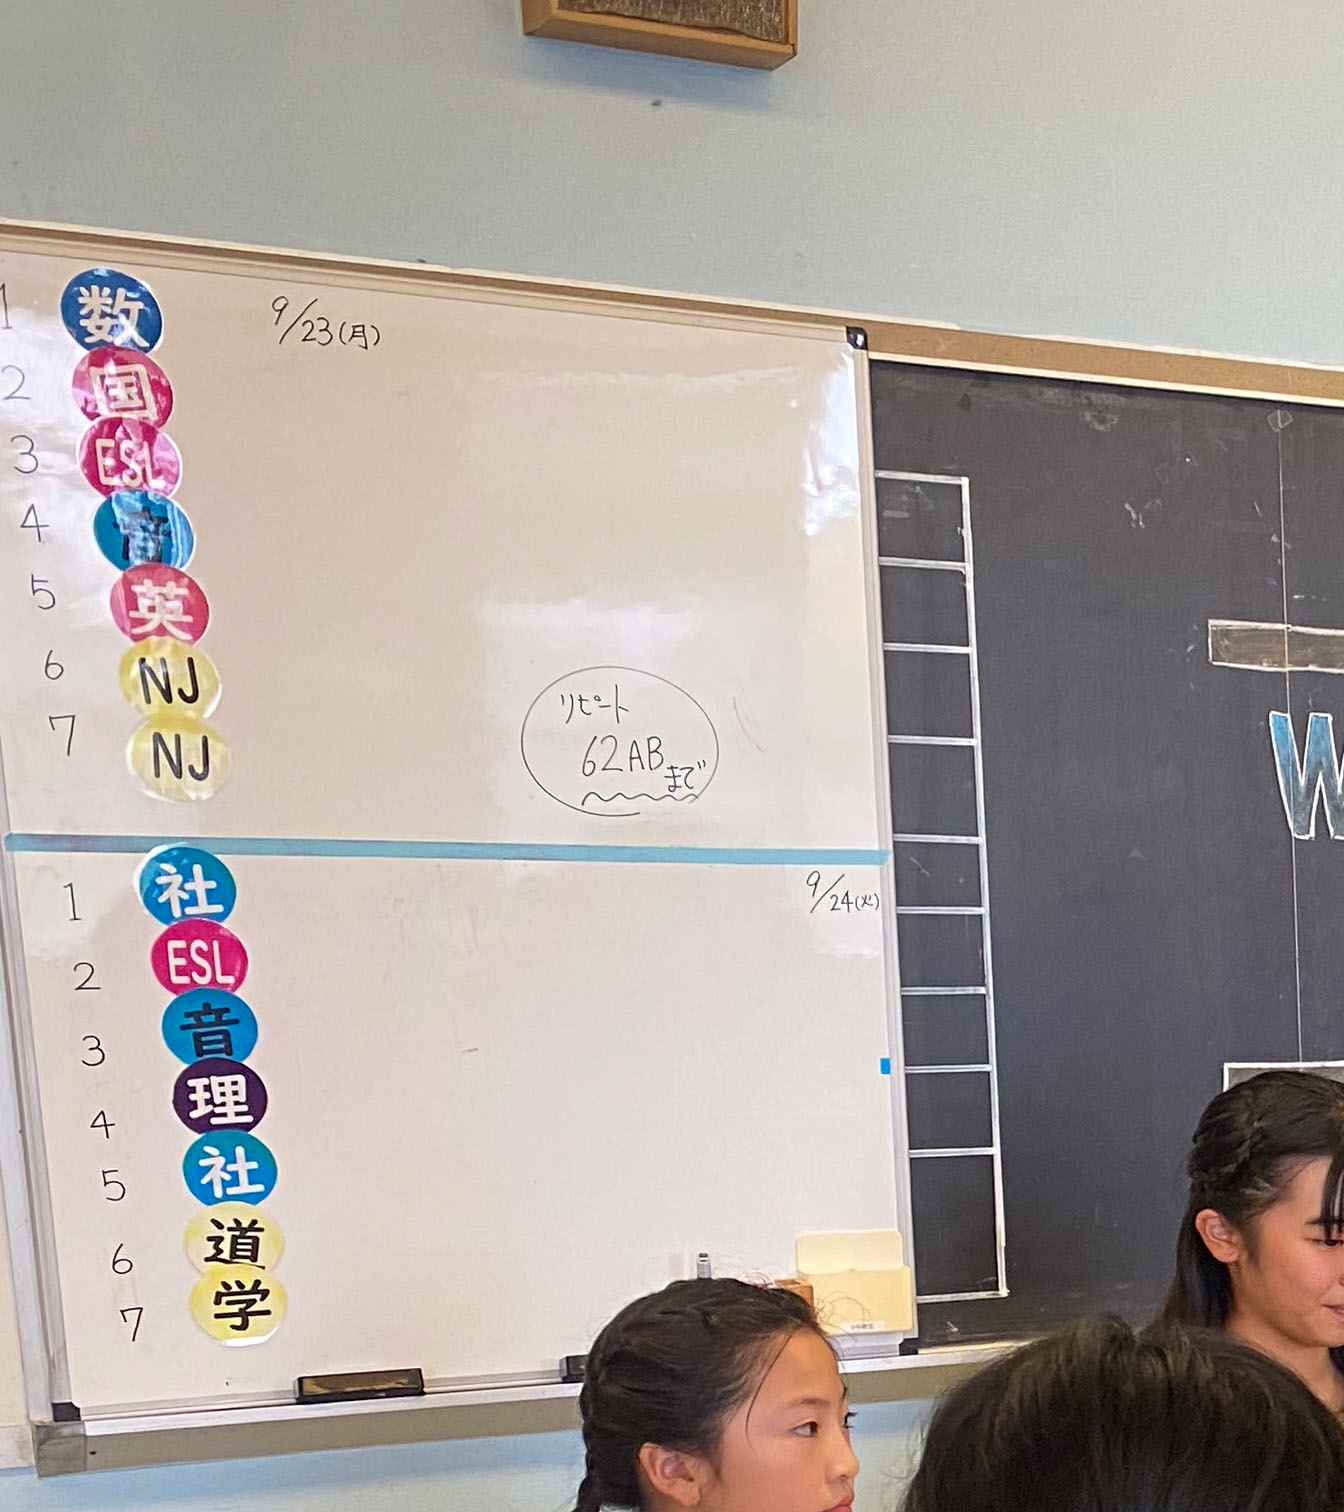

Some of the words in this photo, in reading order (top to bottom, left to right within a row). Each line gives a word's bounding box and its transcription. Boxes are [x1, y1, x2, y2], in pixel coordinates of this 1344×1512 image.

[78, 284, 150, 348] 数
[271, 295, 381, 350] 9/23(月)
[1, 364, 32, 401] 2
[89, 362, 160, 421] 国
[10, 434, 39, 475] 3
[95, 438, 167, 488] ESL
[20, 503, 50, 543] 4
[31, 573, 57, 610] 5
[128, 578, 194, 641] 英
[44, 649, 65, 681] 6
[138, 656, 200, 705] NJ
[49, 714, 76, 757] 7
[152, 731, 211, 782] NJ
[63, 881, 82, 922] 1
[155, 863, 225, 919] 社
[73, 961, 103, 991] 2
[166, 938, 236, 986] ESL
[81, 1034, 106, 1067] 3
[179, 1002, 240, 1058] 音
[186, 1073, 255, 1126] 理
[89, 1109, 116, 1140] 4
[101, 1169, 126, 1202] 5
[198, 1144, 266, 1199] 社
[111, 1242, 134, 1275] 6
[203, 1217, 267, 1270] 道
[119, 1306, 144, 1342] 7
[213, 1278, 273, 1332] 学
